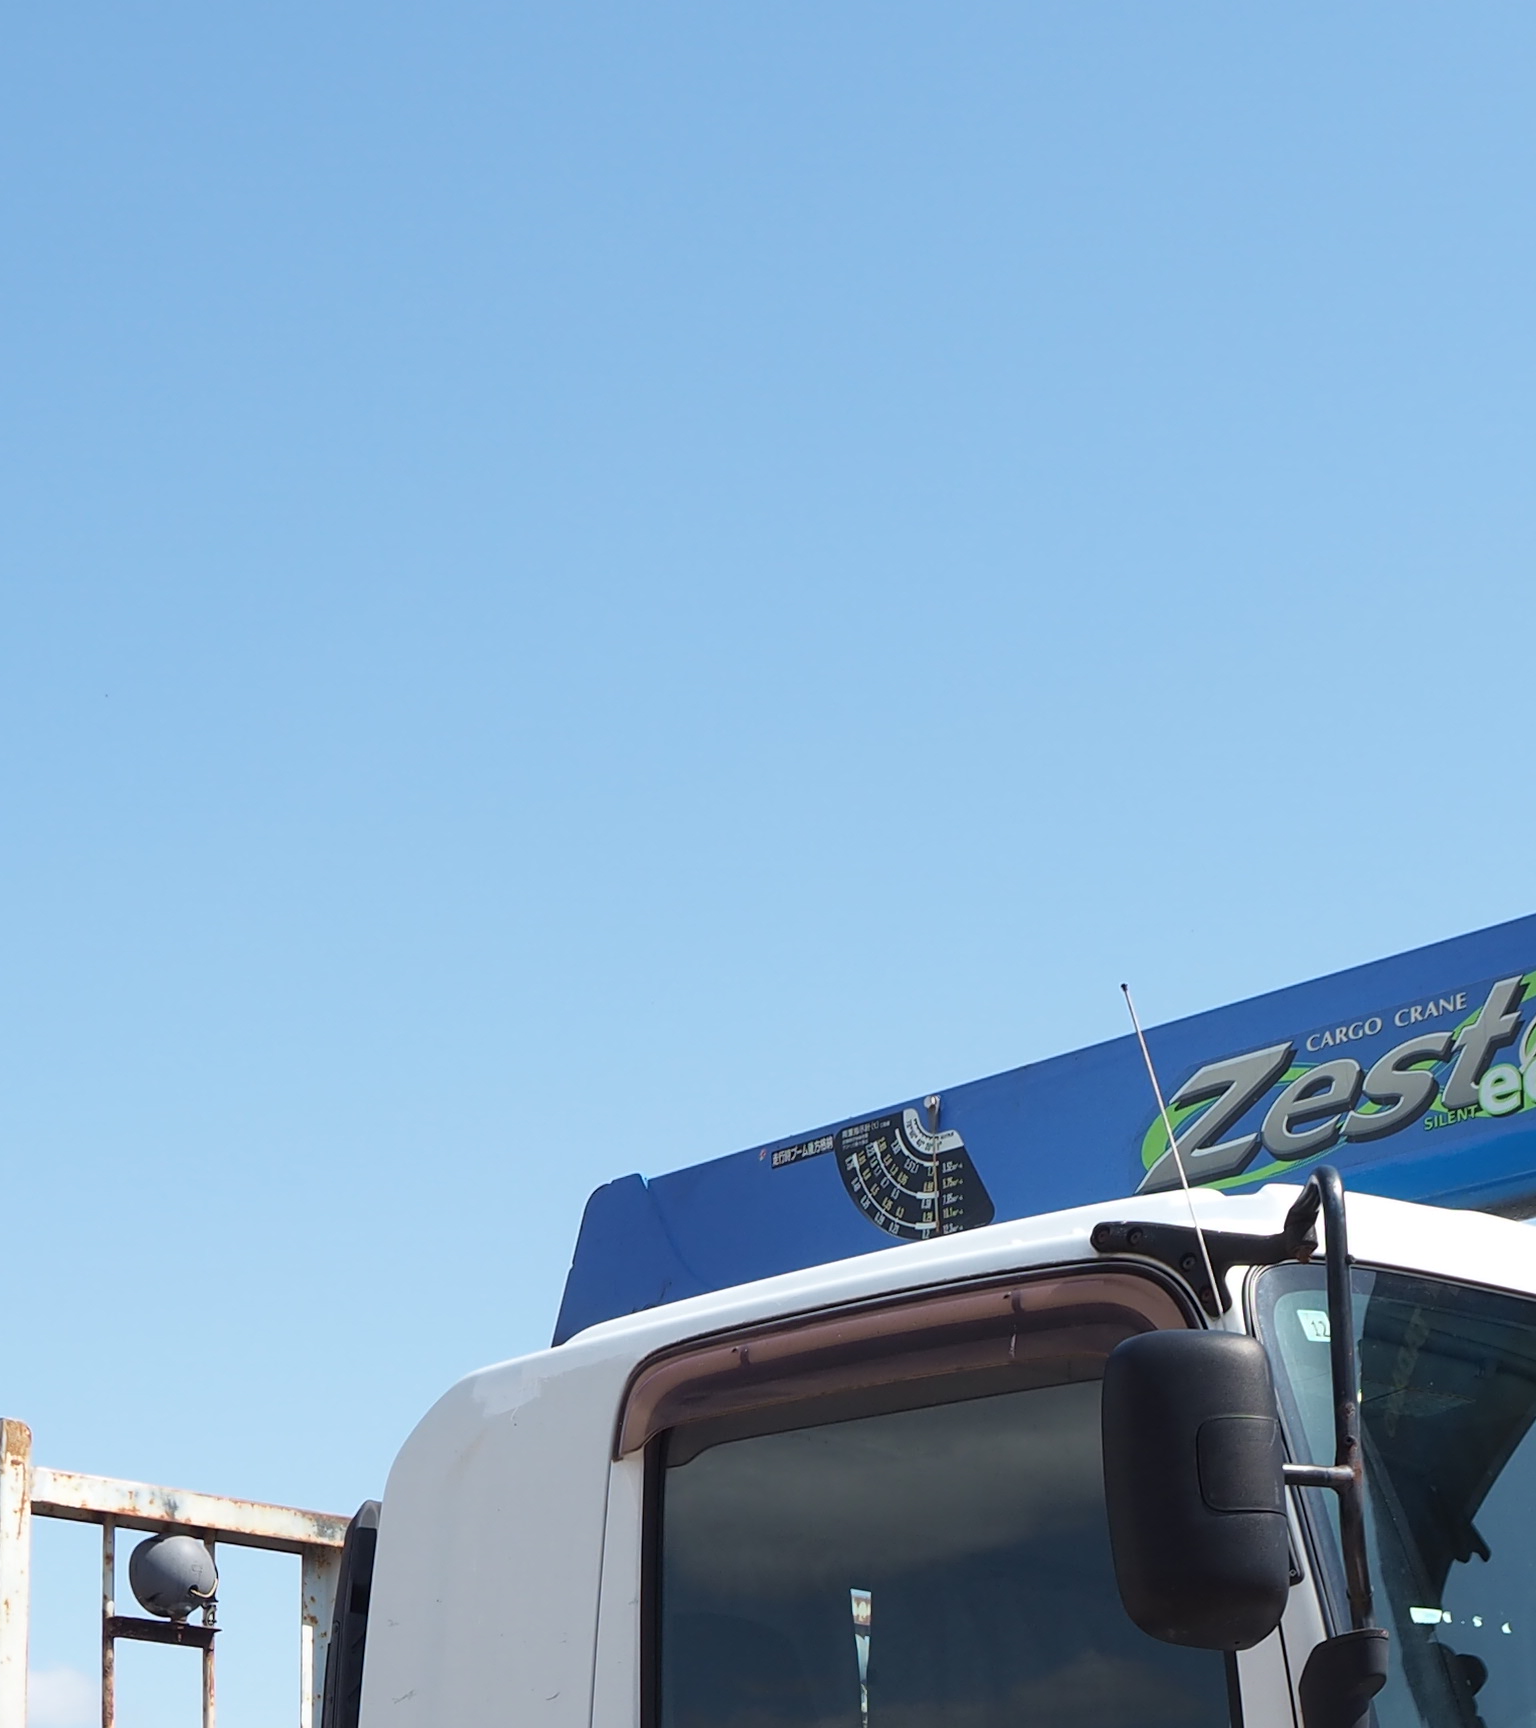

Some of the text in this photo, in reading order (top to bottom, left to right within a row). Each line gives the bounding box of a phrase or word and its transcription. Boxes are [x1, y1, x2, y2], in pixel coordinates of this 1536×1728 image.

[1306, 992, 1468, 1053] CARGO CRANE
[1135, 973, 1527, 1195] Zest
[1424, 1106, 1478, 1132] SILENT
